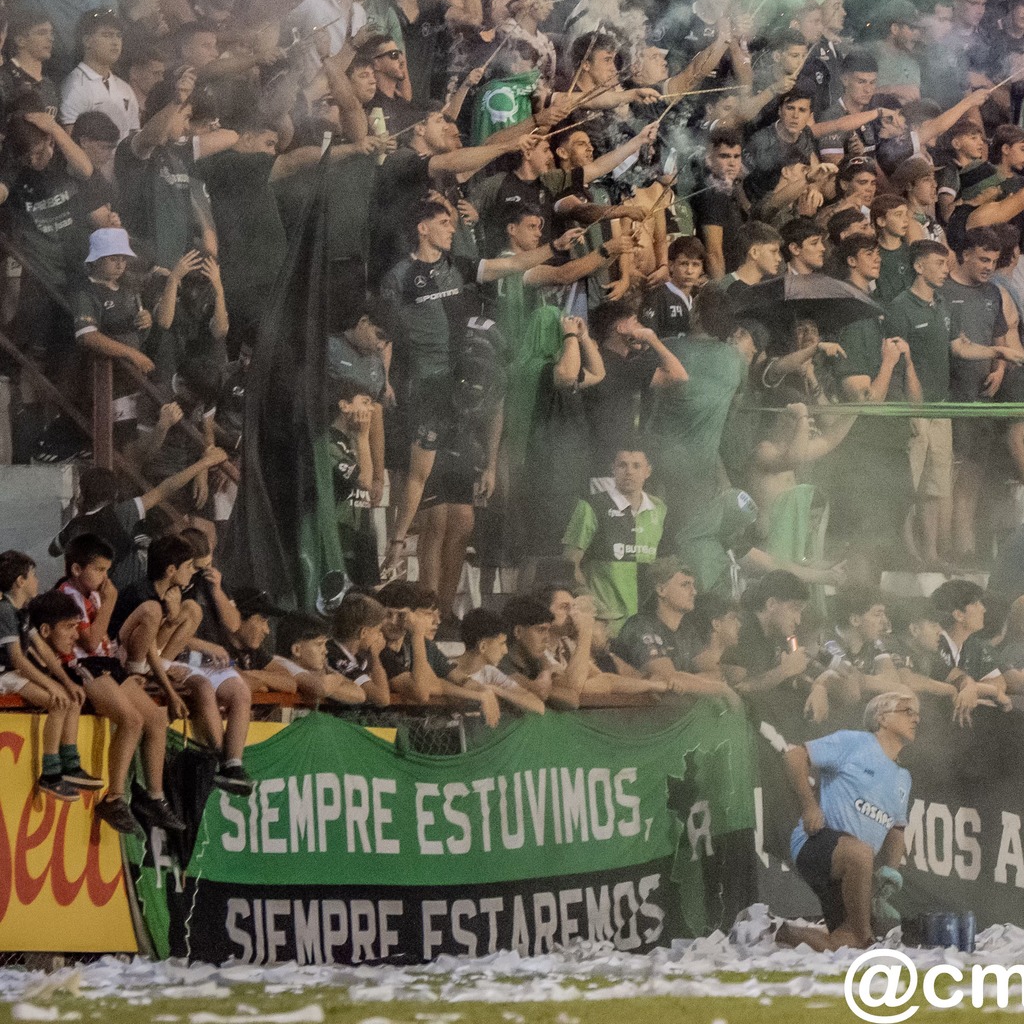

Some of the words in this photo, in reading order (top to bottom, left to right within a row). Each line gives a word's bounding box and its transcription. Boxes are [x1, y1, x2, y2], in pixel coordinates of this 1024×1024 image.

[219, 773, 400, 854] SIEMPRE
[415, 767, 654, 855] ESTUVIMOS,
[225, 897, 403, 967] SIEMPRE
[421, 873, 667, 961] ESTAREMOS
